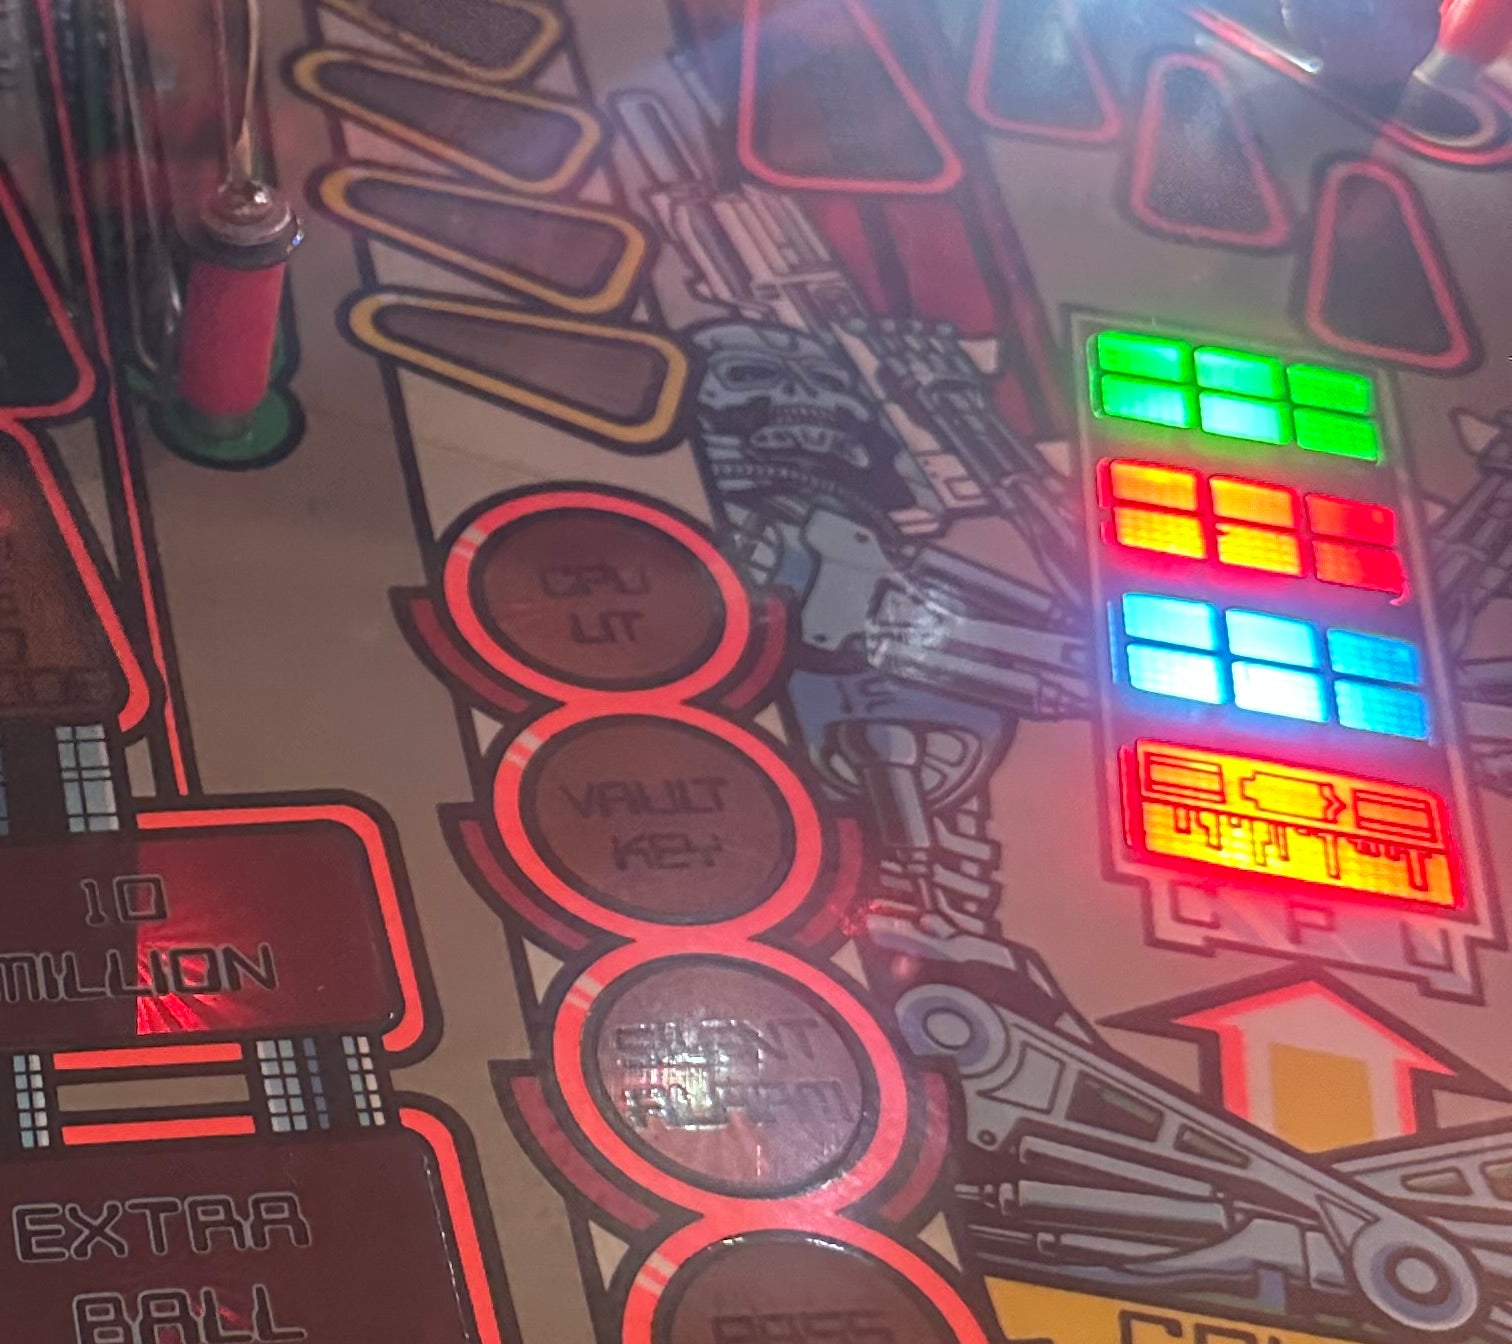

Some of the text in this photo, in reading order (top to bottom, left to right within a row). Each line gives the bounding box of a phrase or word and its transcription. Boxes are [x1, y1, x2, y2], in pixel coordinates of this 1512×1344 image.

[539, 562, 651, 598] CPU
[569, 610, 645, 645] LIT
[560, 777, 728, 820] VAULT
[610, 832, 723, 872] KEY
[80, 873, 168, 926] 10
[12, 1192, 312, 1264] EXTRA
